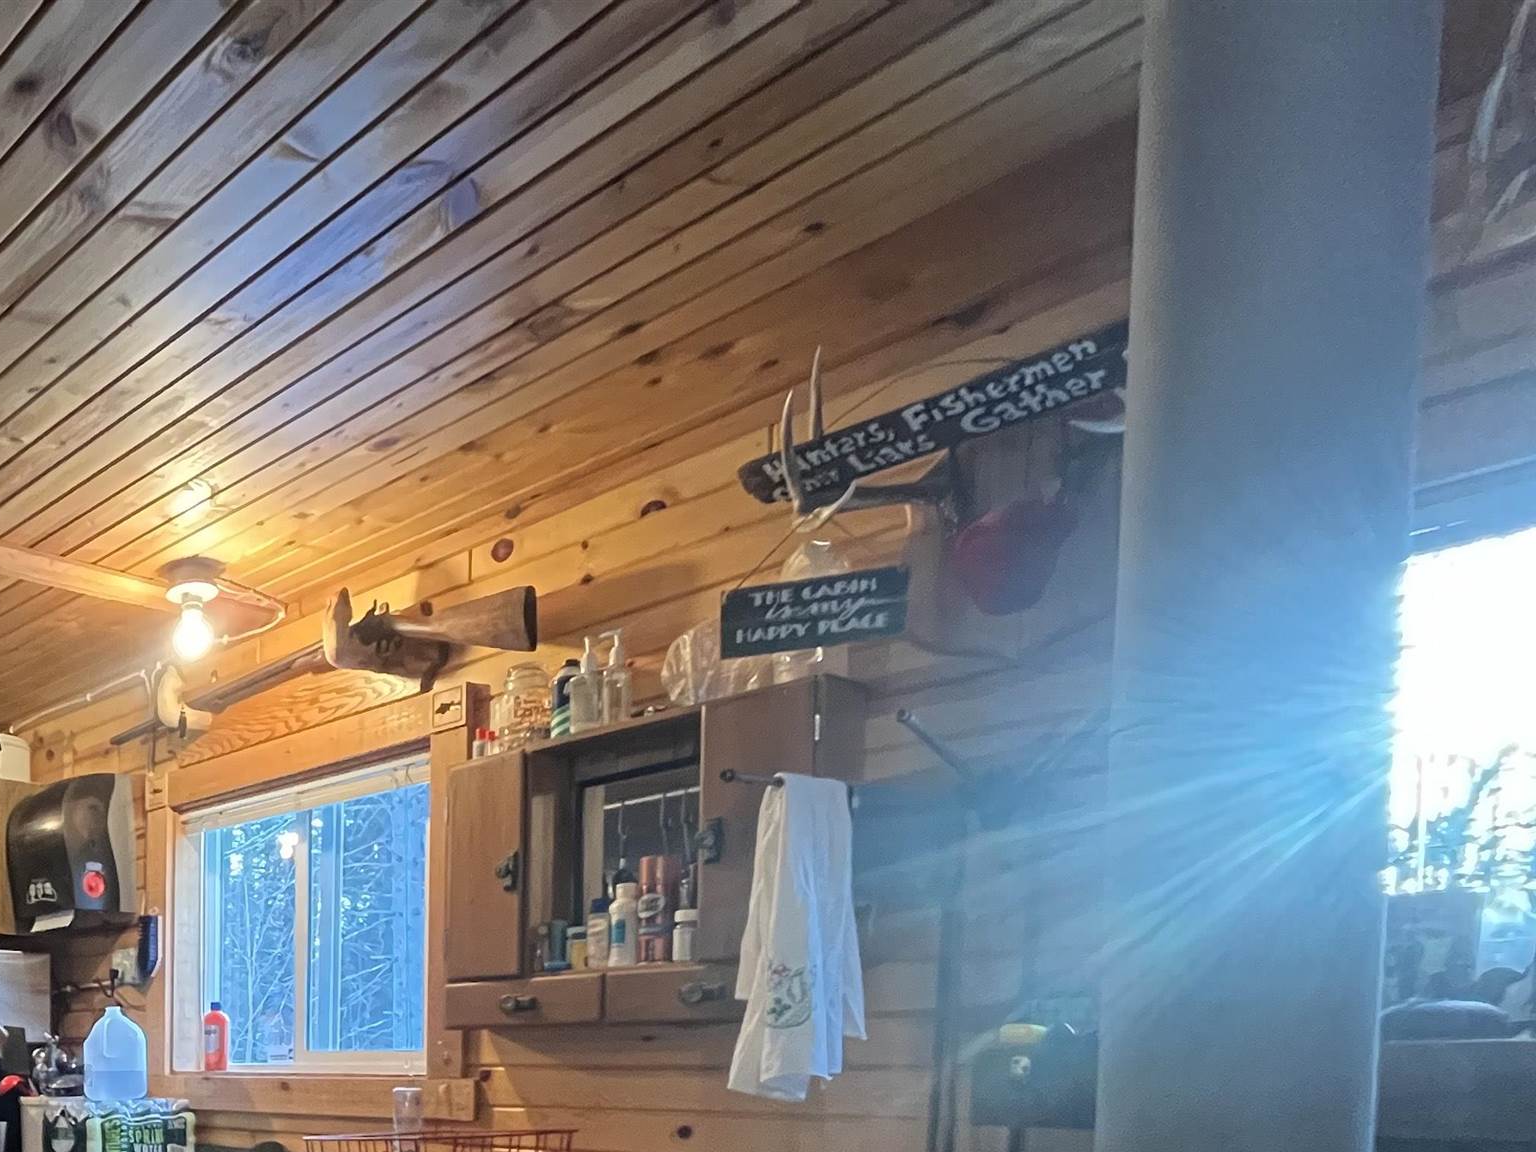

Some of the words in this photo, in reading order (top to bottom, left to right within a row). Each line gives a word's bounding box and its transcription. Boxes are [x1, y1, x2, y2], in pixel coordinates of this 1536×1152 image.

[901, 340, 1097, 432] Fishermen
[846, 433, 936, 473] Liars
[960, 368, 1106, 434] Gather
[749, 588, 793, 607] THE
[801, 577, 878, 600] CABIN
[735, 621, 811, 644] HAPPY
[817, 612, 889, 635] PLACE
